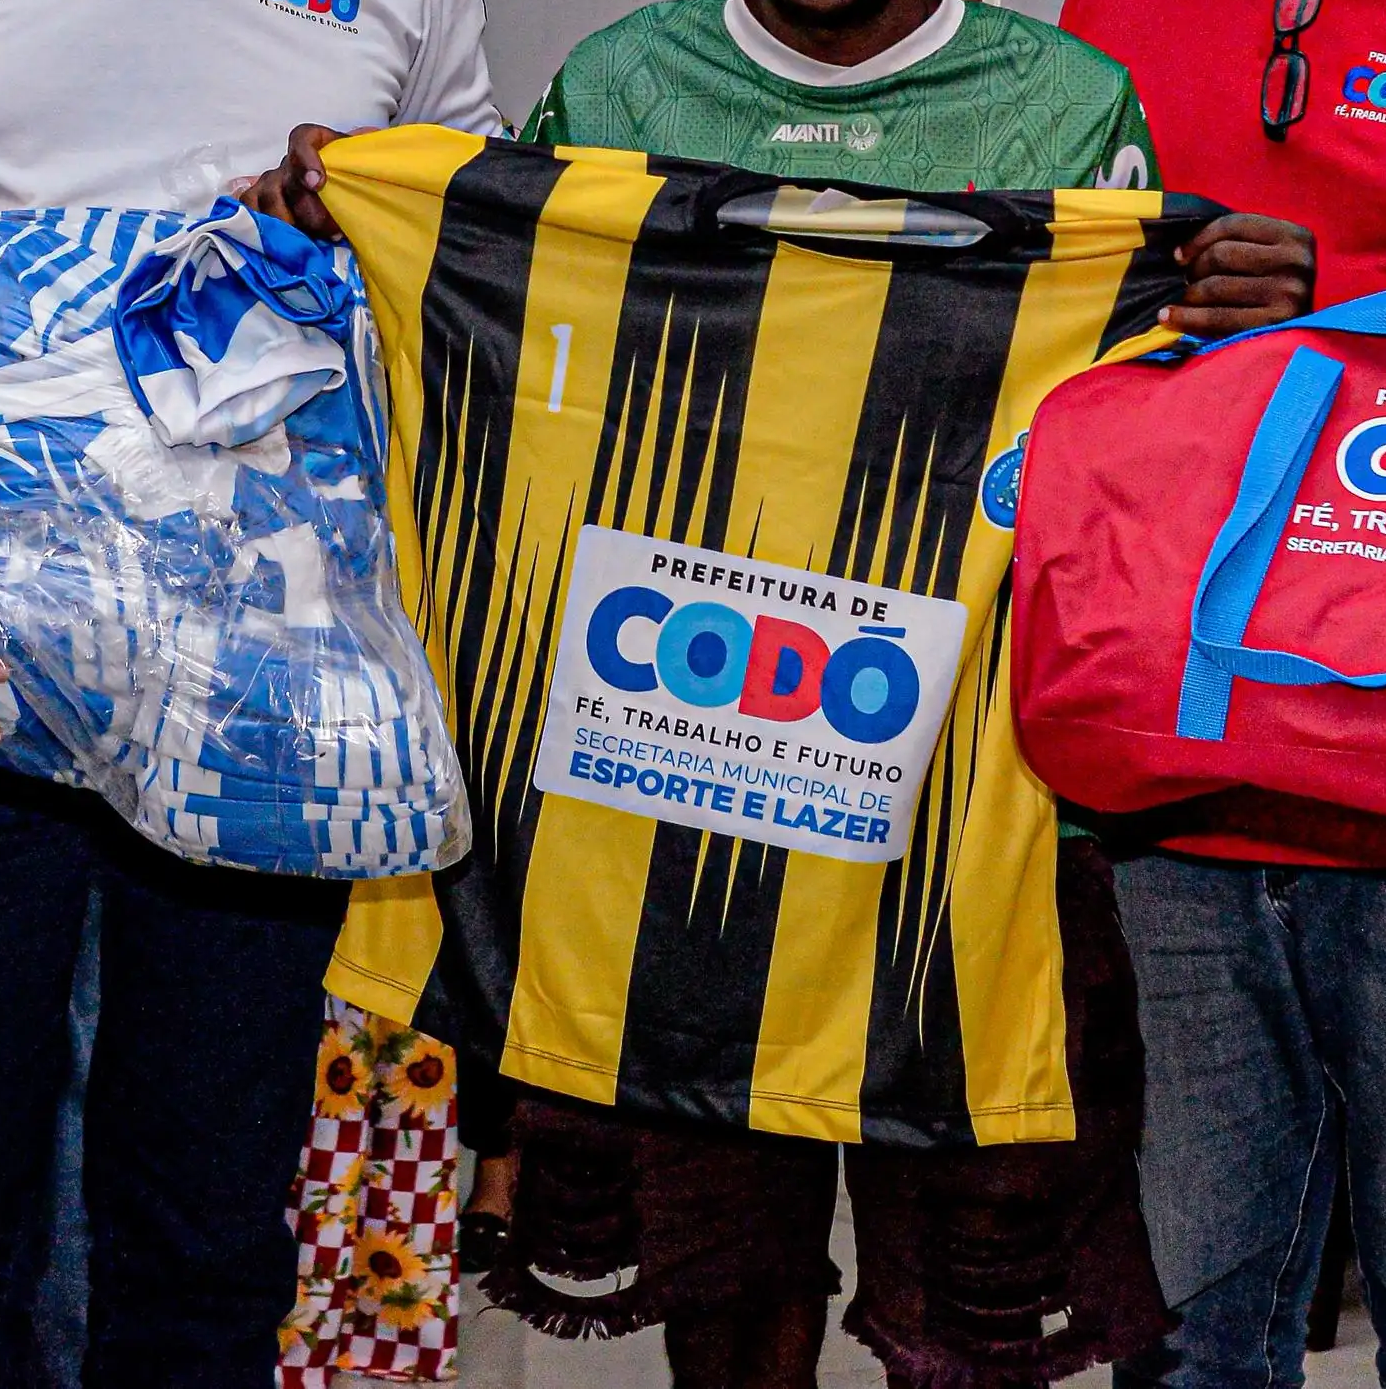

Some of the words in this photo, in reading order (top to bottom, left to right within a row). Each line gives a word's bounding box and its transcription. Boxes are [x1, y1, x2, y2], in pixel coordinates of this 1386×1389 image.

[274, 3, 317, 22] TRABALHO
[326, 20, 359, 35] FUTURO
[771, 123, 839, 142] AVANTI
[548, 323, 573, 412] 1
[1292, 502, 1340, 532] FÉ,
[650, 553, 837, 612] PREFEITURA
[850, 596, 889, 623] DE
[574, 727, 715, 775] SECRETARIA
[722, 761, 852, 806] MUNICIPAL
[860, 791, 893, 813] DE
[575, 696, 610, 724] FÉ,
[622, 706, 762, 753] TRABALHO
[772, 740, 788, 759] E
[797, 745, 903, 783] FUTURO
[569, 750, 736, 814] ESPORTE
[742, 790, 767, 820] E
[773, 798, 891, 844] LAZER
